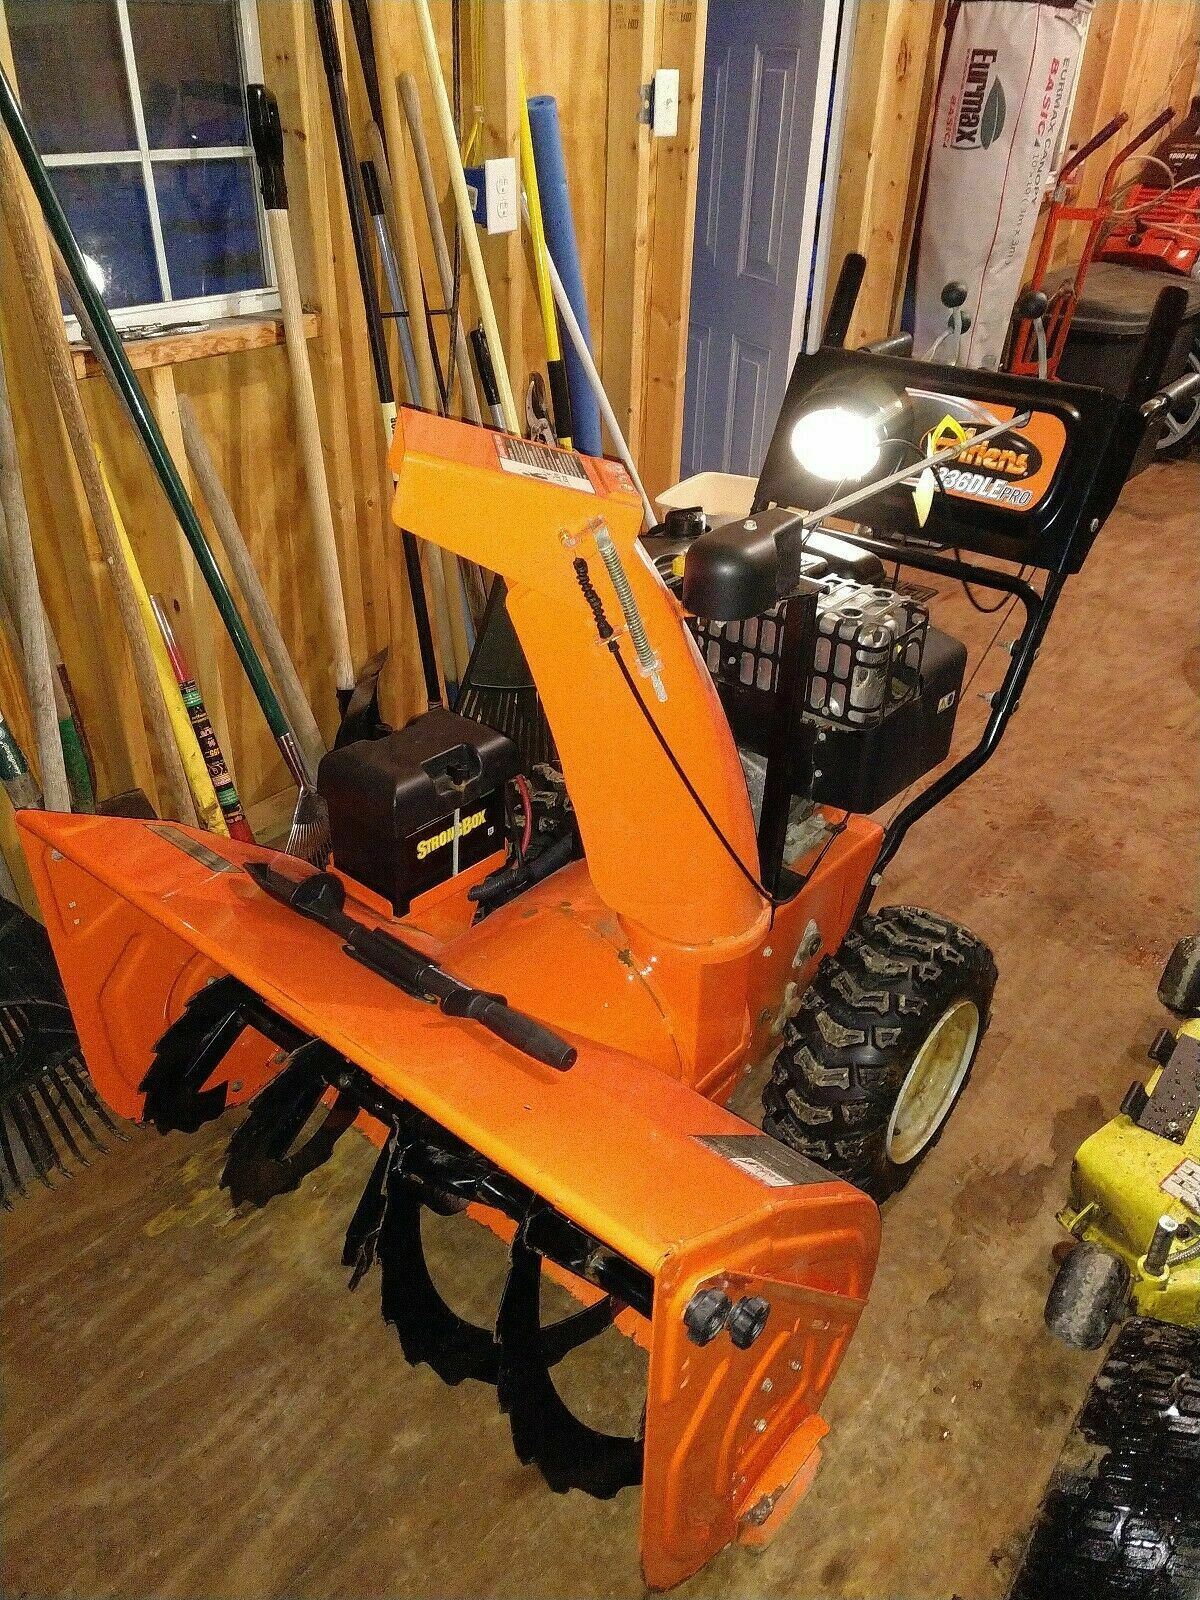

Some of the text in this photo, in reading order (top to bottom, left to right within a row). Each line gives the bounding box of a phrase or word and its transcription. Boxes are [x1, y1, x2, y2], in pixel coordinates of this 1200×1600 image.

[944, 94, 957, 140] BASIC
[956, 49, 998, 143] Eurmax
[1031, 57, 1071, 204] EURMAX CANOPY
[1037, 58, 1060, 136] BASIC
